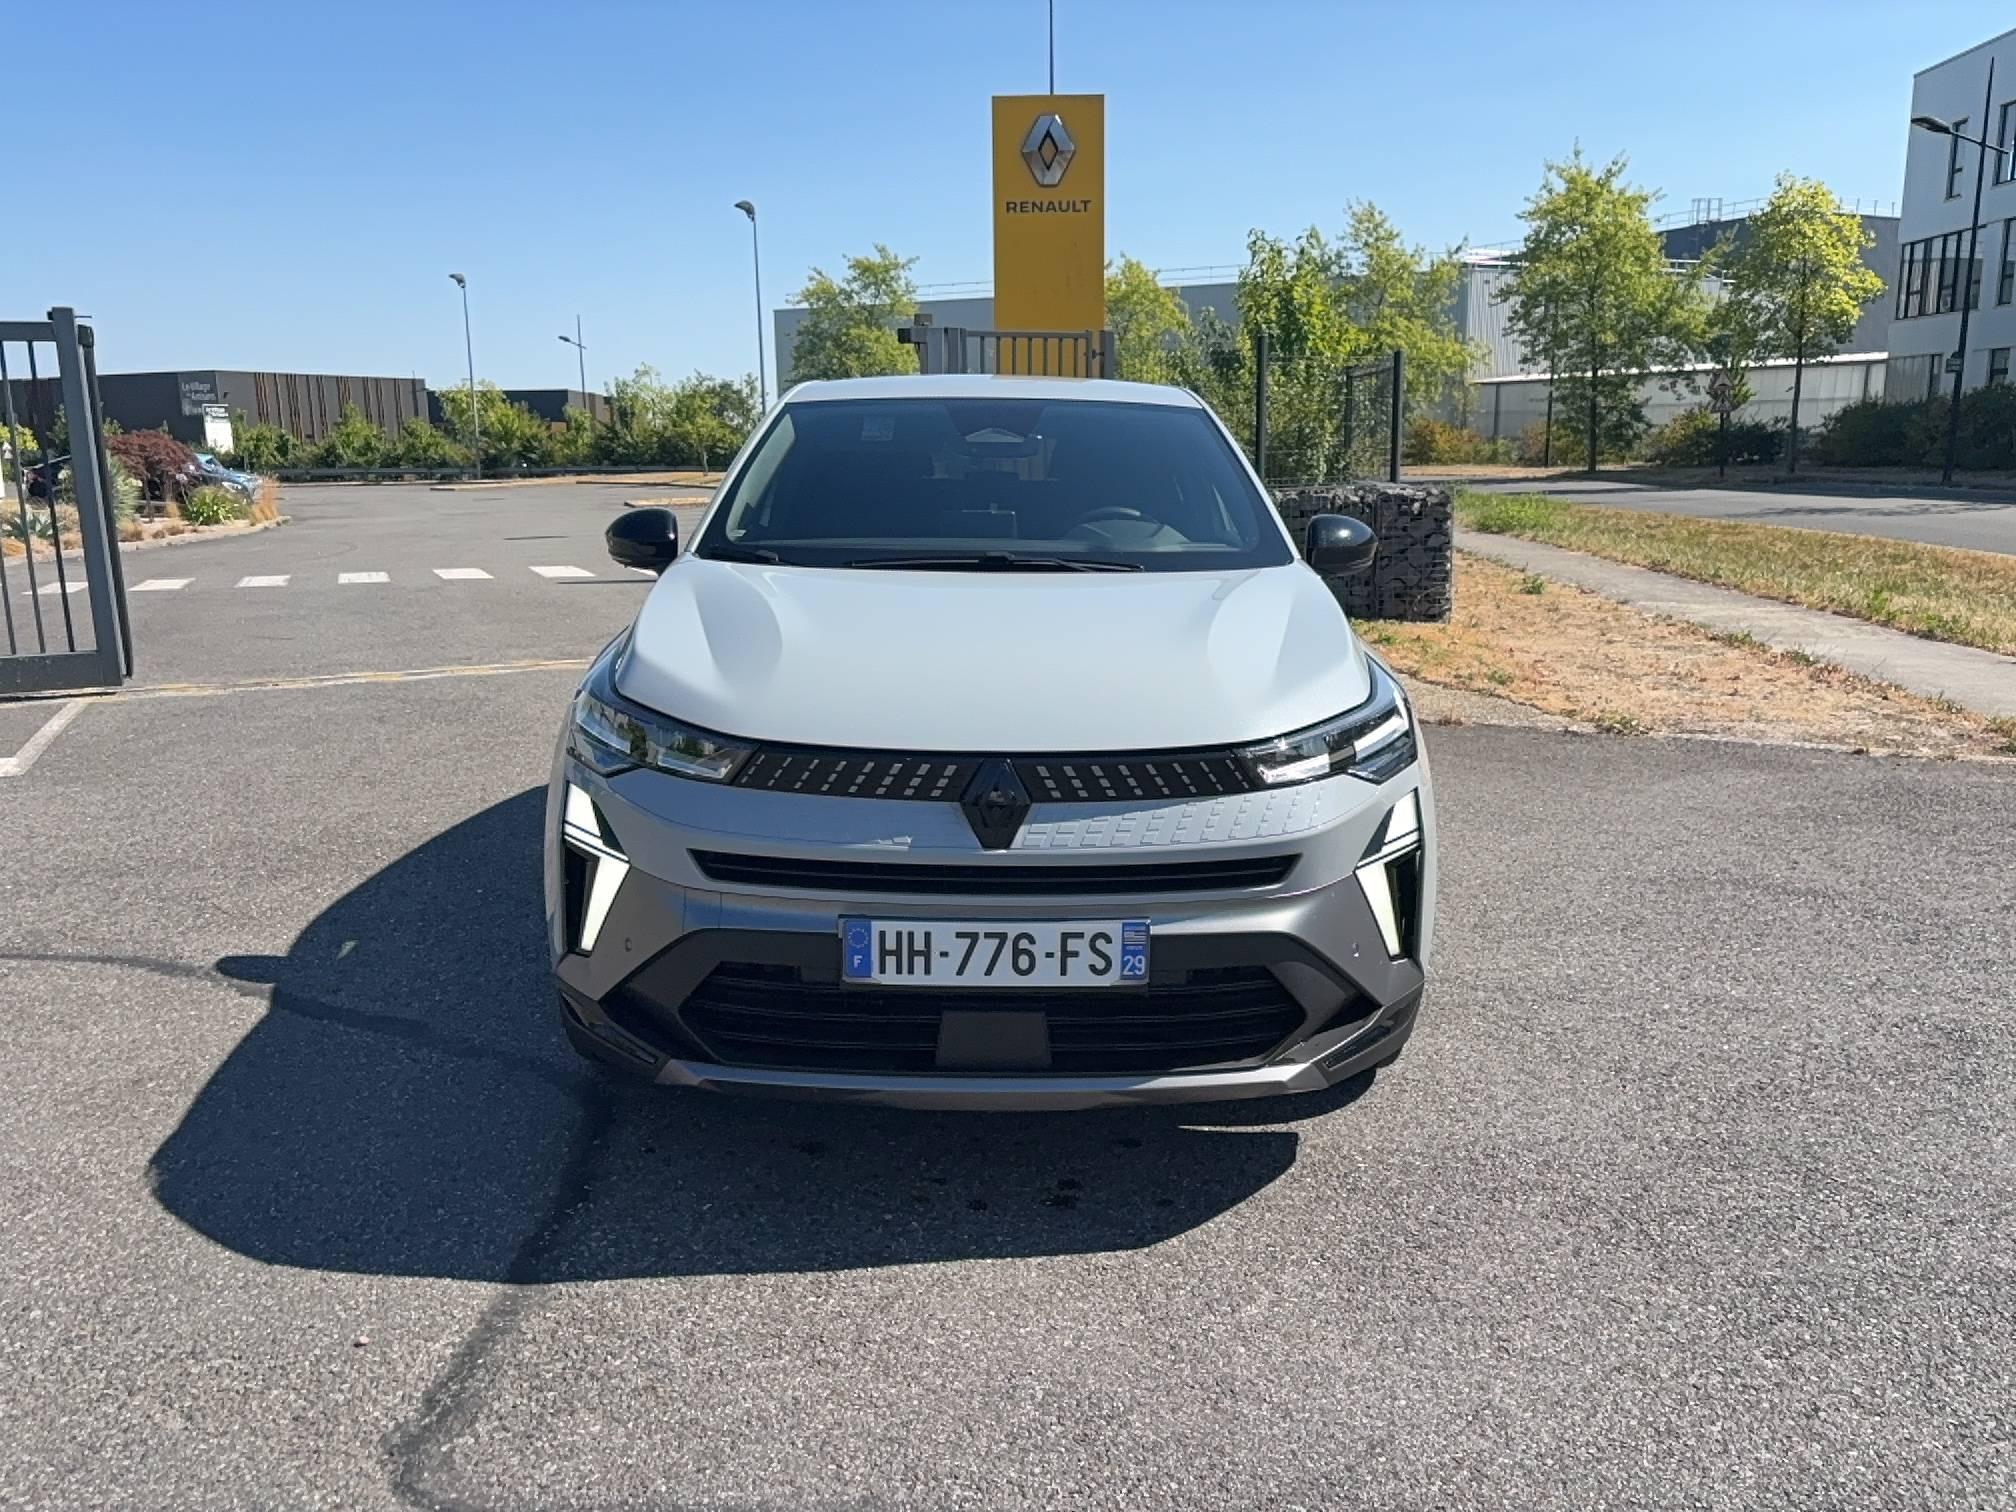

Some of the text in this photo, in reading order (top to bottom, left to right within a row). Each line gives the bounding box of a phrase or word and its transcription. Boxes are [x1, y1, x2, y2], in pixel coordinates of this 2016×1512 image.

[1006, 200, 1092, 213] RENAULT
[853, 954, 863, 969] F
[878, 930, 1113, 977] HH-776-FS
[1122, 954, 1146, 976] 29
